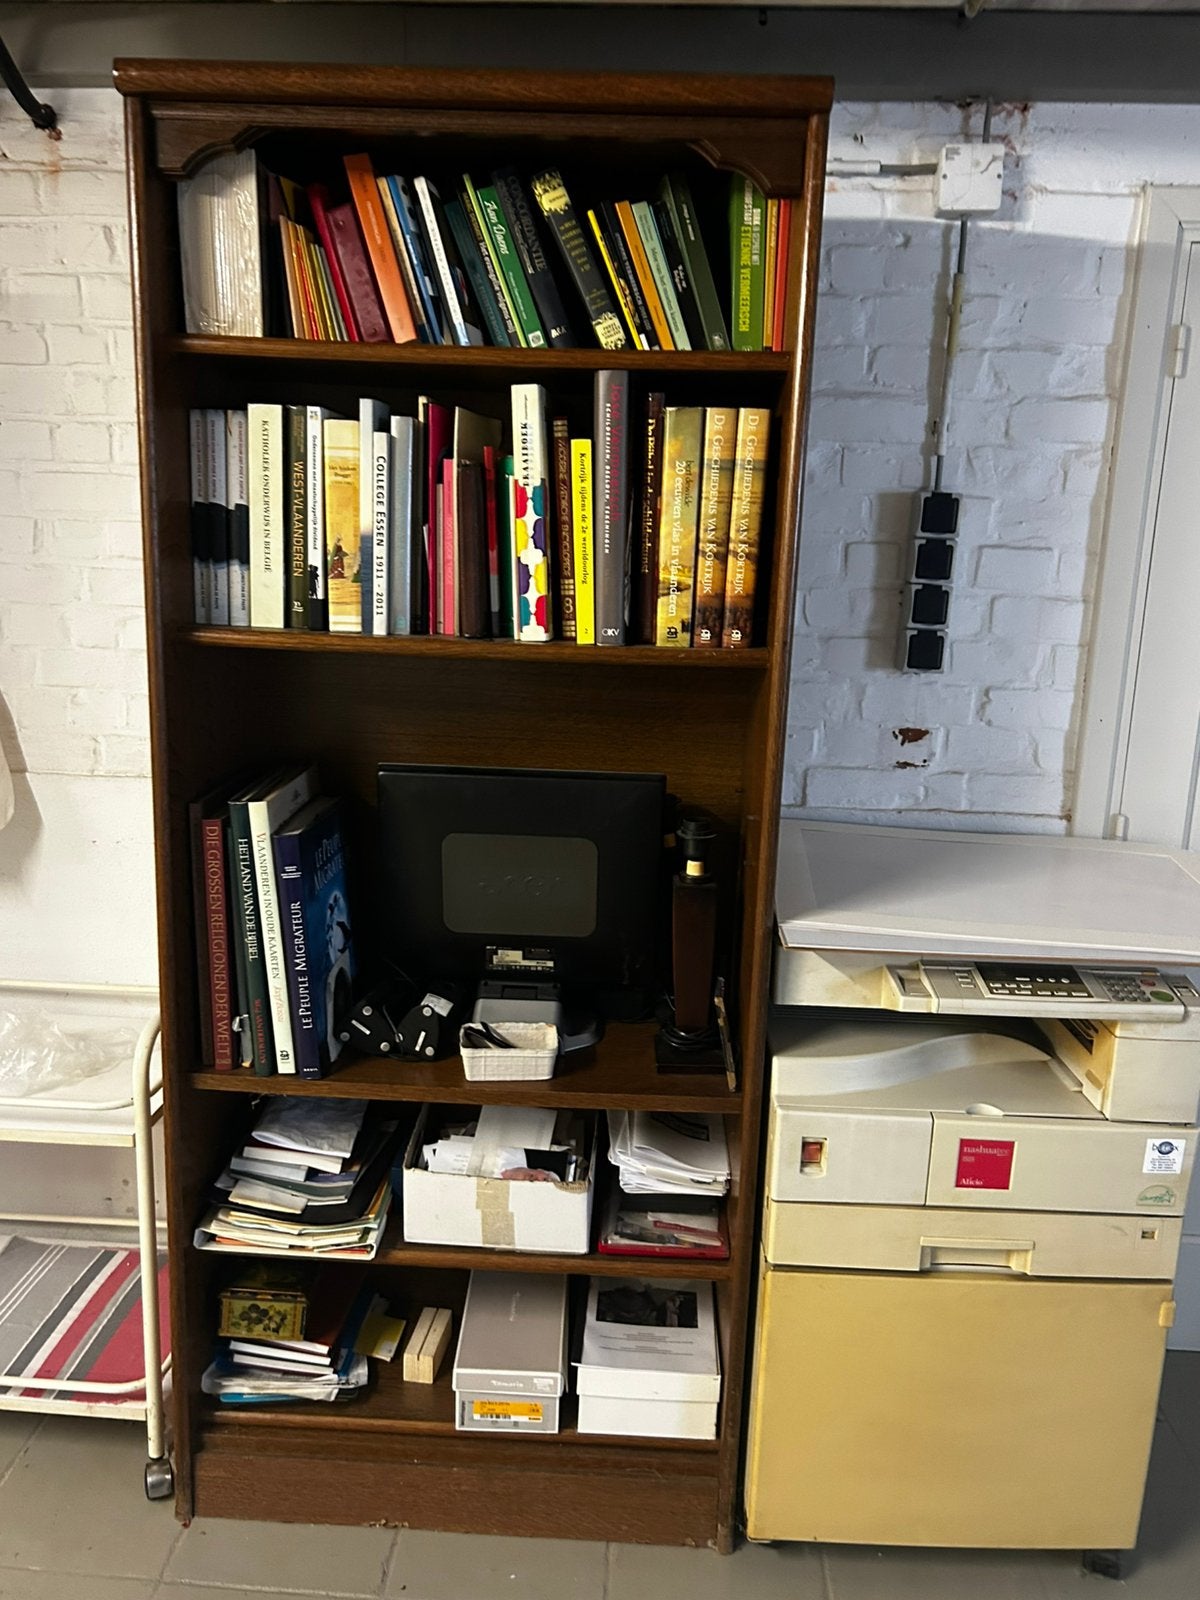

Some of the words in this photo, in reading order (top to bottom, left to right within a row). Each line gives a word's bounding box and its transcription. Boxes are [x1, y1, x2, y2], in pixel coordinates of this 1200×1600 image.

[740, 225, 751, 265] ETIENNE
[738, 267, 750, 331] VERMEERSCH
[261, 419, 270, 472] KATHOLIEK
[375, 455, 386, 506] COLLEGE
[578, 452, 586, 482] Kortrijk
[675, 460, 685, 474] 20
[707, 435, 724, 514] GESCHIEDENIS
[740, 435, 757, 514] GESCHIEDENIS
[261, 474, 270, 526] ONDERWIJS
[673, 477, 683, 518] eeuwen
[262, 528, 270, 538] IN
[292, 460, 304, 577] WEST-VLAANDEREN
[375, 511, 386, 546] ESSEN
[581, 514, 586, 522] de
[671, 521, 682, 542] vlas
[375, 555, 383, 579] 1911
[580, 536, 589, 585] wereldoorlog
[671, 545, 681, 555] in
[702, 543, 717, 594] KORTRIJK
[733, 543, 749, 594] KORTRIJK
[375, 591, 383, 615] 2011
[668, 558, 681, 616] vlaanderen
[563, 597, 573, 614] 8
[602, 628, 620, 636] OKV
[205, 825, 219, 847] DIE
[237, 837, 250, 860] HET
[206, 849, 222, 910] GROSSEN
[239, 860, 252, 892] LAND
[254, 832, 273, 896] VLAANDEREN
[242, 892, 255, 915] VAN
[263, 898, 272, 908] IN
[244, 915, 256, 930] DE
[263, 908, 275, 934] OUDE
[290, 900, 307, 971] MIGRATEUR
[210, 912, 226, 988] RELIGIONEN
[244, 930, 259, 961] BIJBEL
[266, 936, 281, 980] KAARTEN
[214, 992, 228, 1016] DER
[296, 975, 310, 1015] PEUPLE
[216, 1019, 230, 1053] WELT
[302, 1017, 312, 1028] LE
